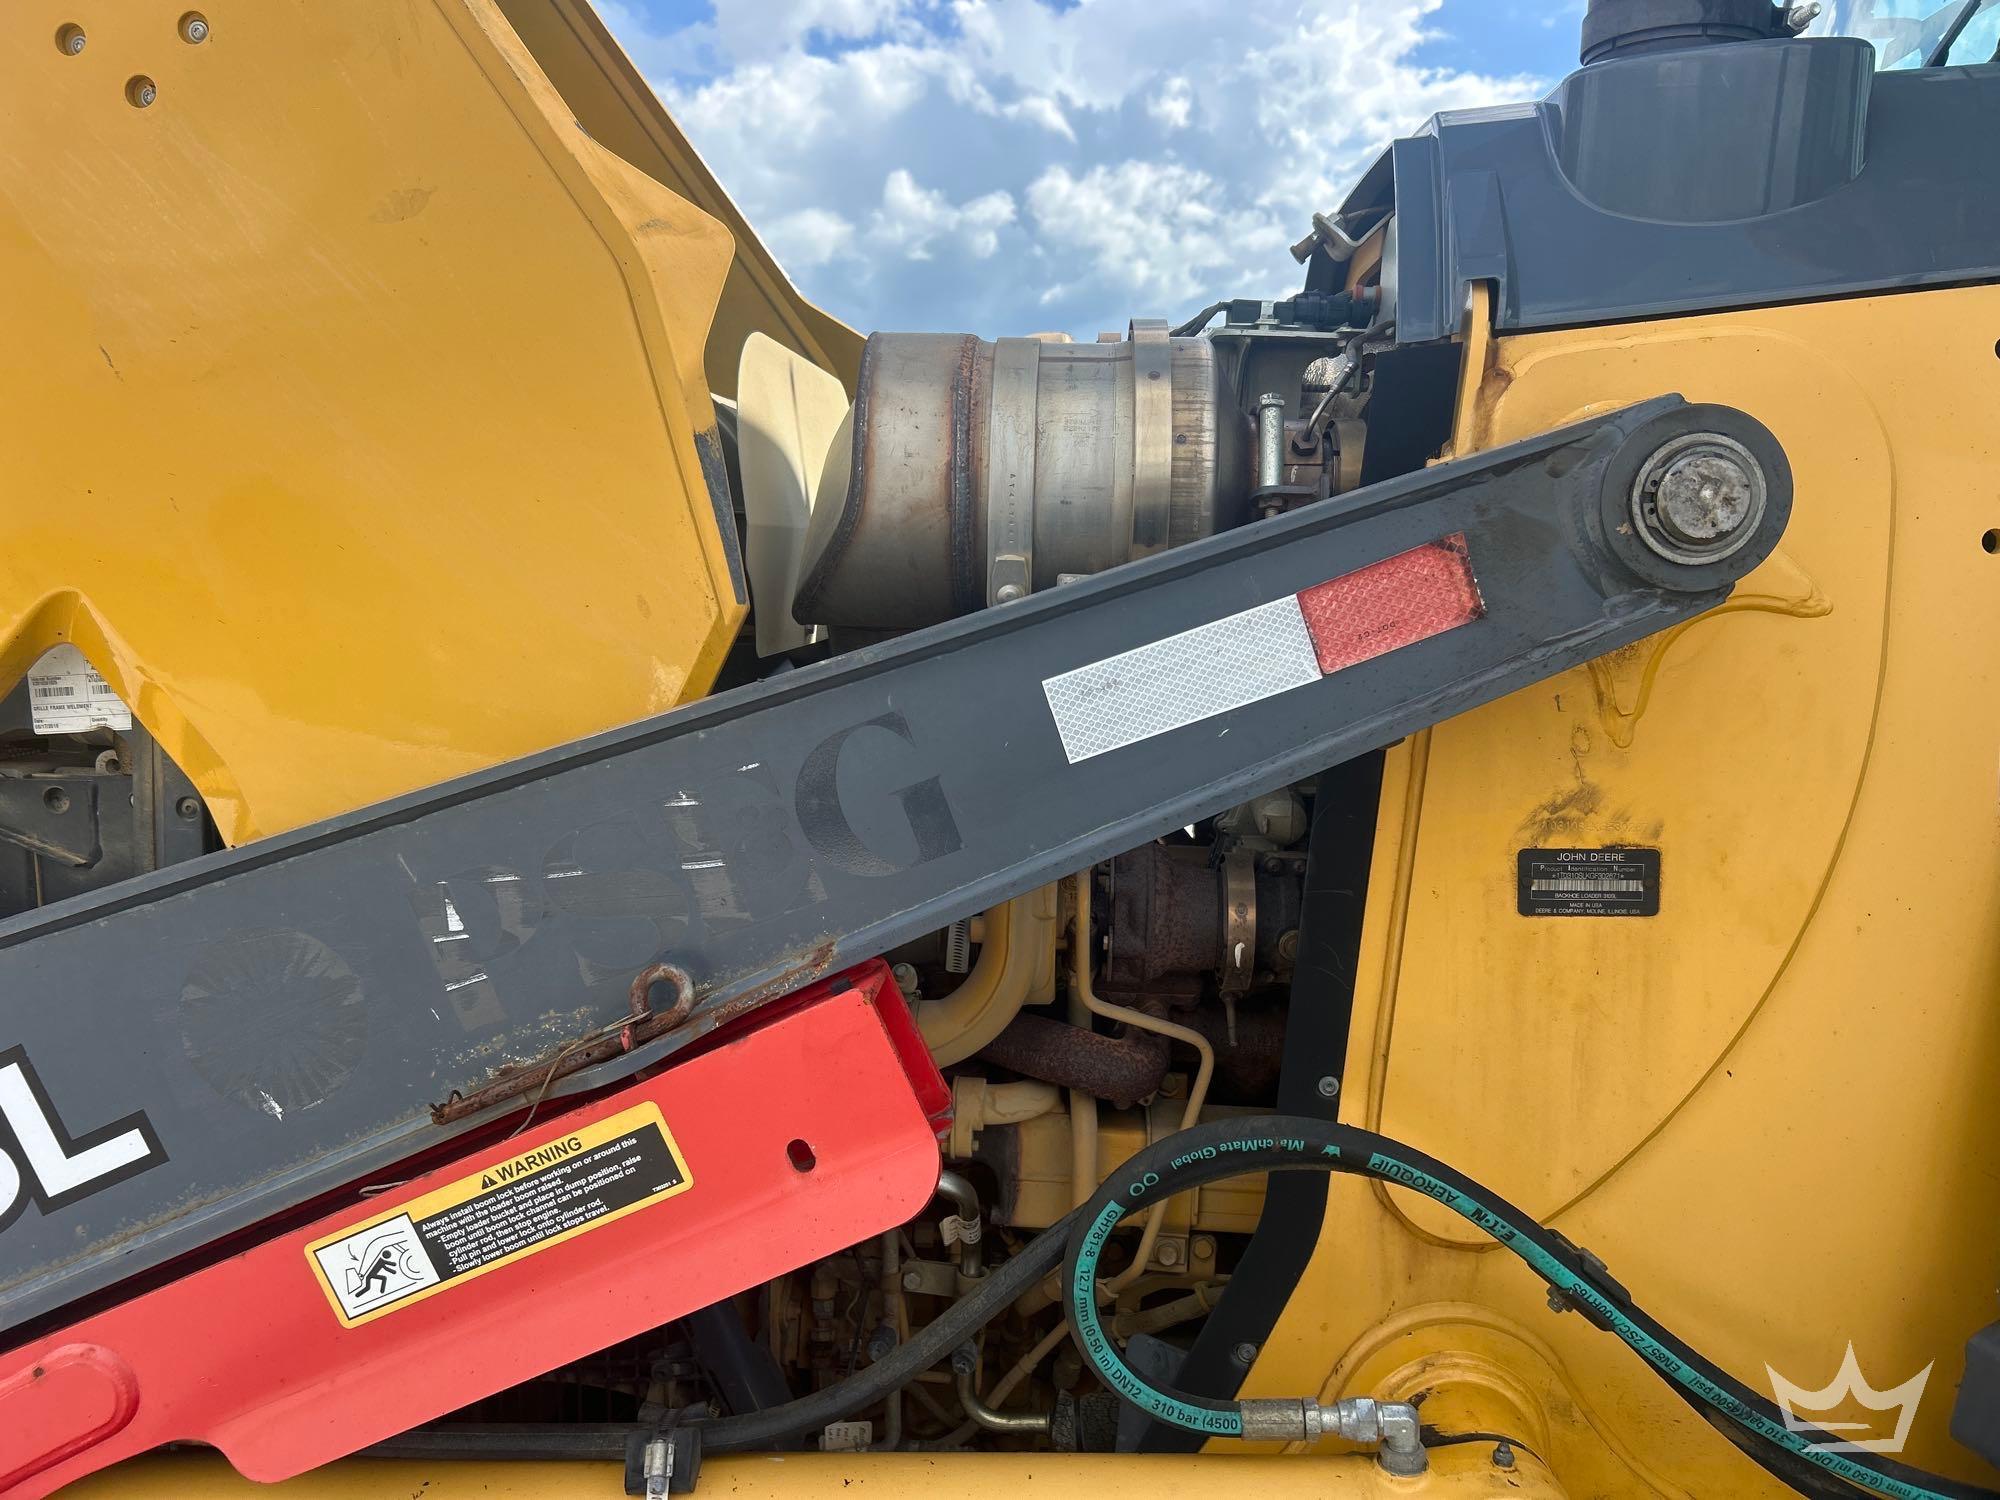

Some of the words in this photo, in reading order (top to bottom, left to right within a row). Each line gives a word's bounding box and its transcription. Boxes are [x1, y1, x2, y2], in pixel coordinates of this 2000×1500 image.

[1540, 864, 1563, 872] Product
[1567, 864, 1608, 872] Identification
[1613, 864, 1636, 872] Number
[1556, 853, 1586, 862] JOHN
[1590, 853, 1625, 862] DEERE
[495, 1137, 582, 1181] WARNING
[1170, 1146, 1216, 1170] Global
[422, 1216, 450, 1232] Always
[449, 1205, 474, 1220] install
[473, 1197, 497, 1210] boom
[496, 1189, 514, 1200] lock
[513, 1179, 539, 1193] before
[539, 1166, 572, 1182] working
[572, 1161, 583, 1169] on
[583, 1156, 592, 1164] or
[593, 1143, 621, 1160] around
[621, 1138, 637, 1148] this
[465, 1218, 490, 1232] loader
[490, 1206, 518, 1222] bucket
[518, 1199, 533, 1211] and
[533, 1192, 555, 1205] place
[564, 1178, 587, 1191] dump
[587, 1164, 622, 1183] position,
[621, 1155, 641, 1167] raise
[1372, 1159, 1459, 1202] AEROQUIP
[425, 1222, 458, 1239] machine
[458, 1214, 476, 1225] with
[475, 1209, 489, 1218] the
[488, 1198, 513, 1213] loader
[513, 1189, 537, 1202] boom
[537, 1177, 564, 1193] raised.
[444, 1234, 467, 1250] boom
[467, 1228, 485, 1240] until
[484, 1220, 508, 1233] boom
[507, 1212, 526, 1224] lock
[526, 1198, 557, 1216] channel
[557, 1194, 572, 1203] can
[571, 1189, 583, 1197] be
[583, 1170, 624, 1194] positioned
[625, 1167, 636, 1175] on
[448, 1241, 479, 1257] cylinder
[479, 1233, 496, 1245] rod,
[495, 1227, 514, 1237] then
[514, 1219, 532, 1230] stop
[532, 1208, 561, 1223] engine.
[468, 1249, 482, 1259] pin
[482, 1241, 497, 1253] and
[496, 1233, 518, 1246] lower
[518, 1226, 537, 1237] lock
[537, 1219, 555, 1230] onto
[555, 1205, 586, 1222] cylinder
[587, 1198, 604, 1209] rod.
[481, 1248, 503, 1261] lower
[503, 1239, 527, 1252] boom
[527, 1230, 545, 1243] until
[544, 1224, 563, 1236] lock
[562, 1216, 585, 1228] stops
[585, 1204, 610, 1219] travel.
[1085, 1210, 1117, 1257] GH781-8
[1079, 1269, 1090, 1293] 12.7
[1079, 1297, 1088, 1322] mm
[1083, 1324, 1103, 1354] (0.50
[1099, 1353, 1114, 1371] in)
[1643, 1345, 1682, 1373] EN857
[1111, 1368, 1142, 1399] DN12
[1151, 1399, 1175, 1416] 310
[1177, 1411, 1199, 1424] bar
[1202, 1415, 1238, 1430] (4500
[1852, 1470, 1883, 1488] (0.50
[1886, 1483, 1911, 1497] mm
